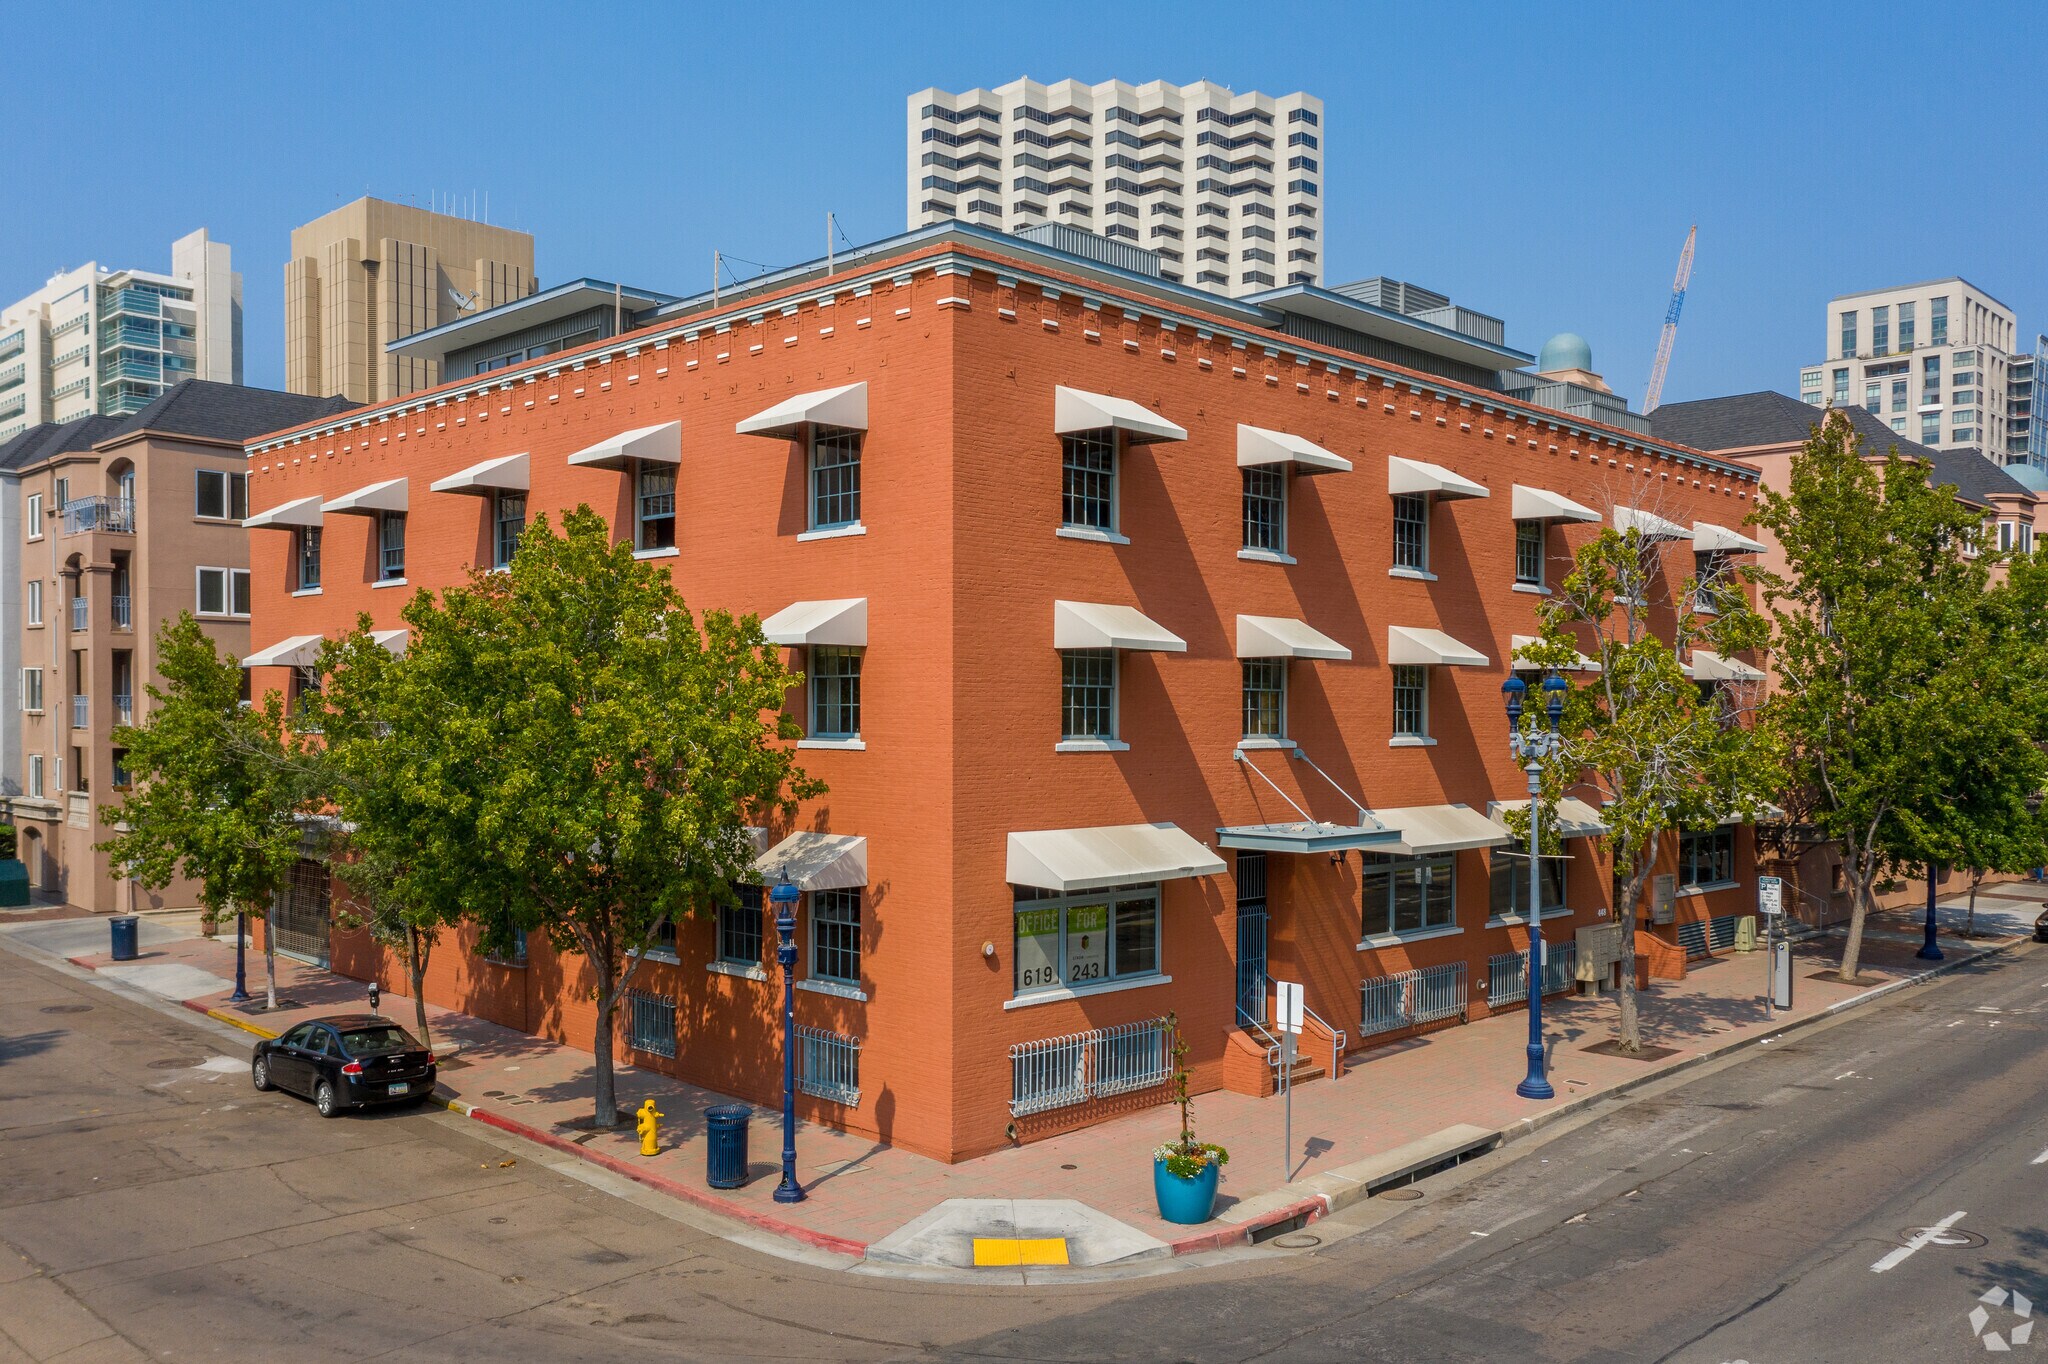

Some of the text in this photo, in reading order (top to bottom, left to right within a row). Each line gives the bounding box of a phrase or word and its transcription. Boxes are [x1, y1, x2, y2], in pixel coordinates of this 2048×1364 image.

[1018, 912, 1097, 933] OFFICE FOR
[1023, 962, 1099, 986] 619 243
